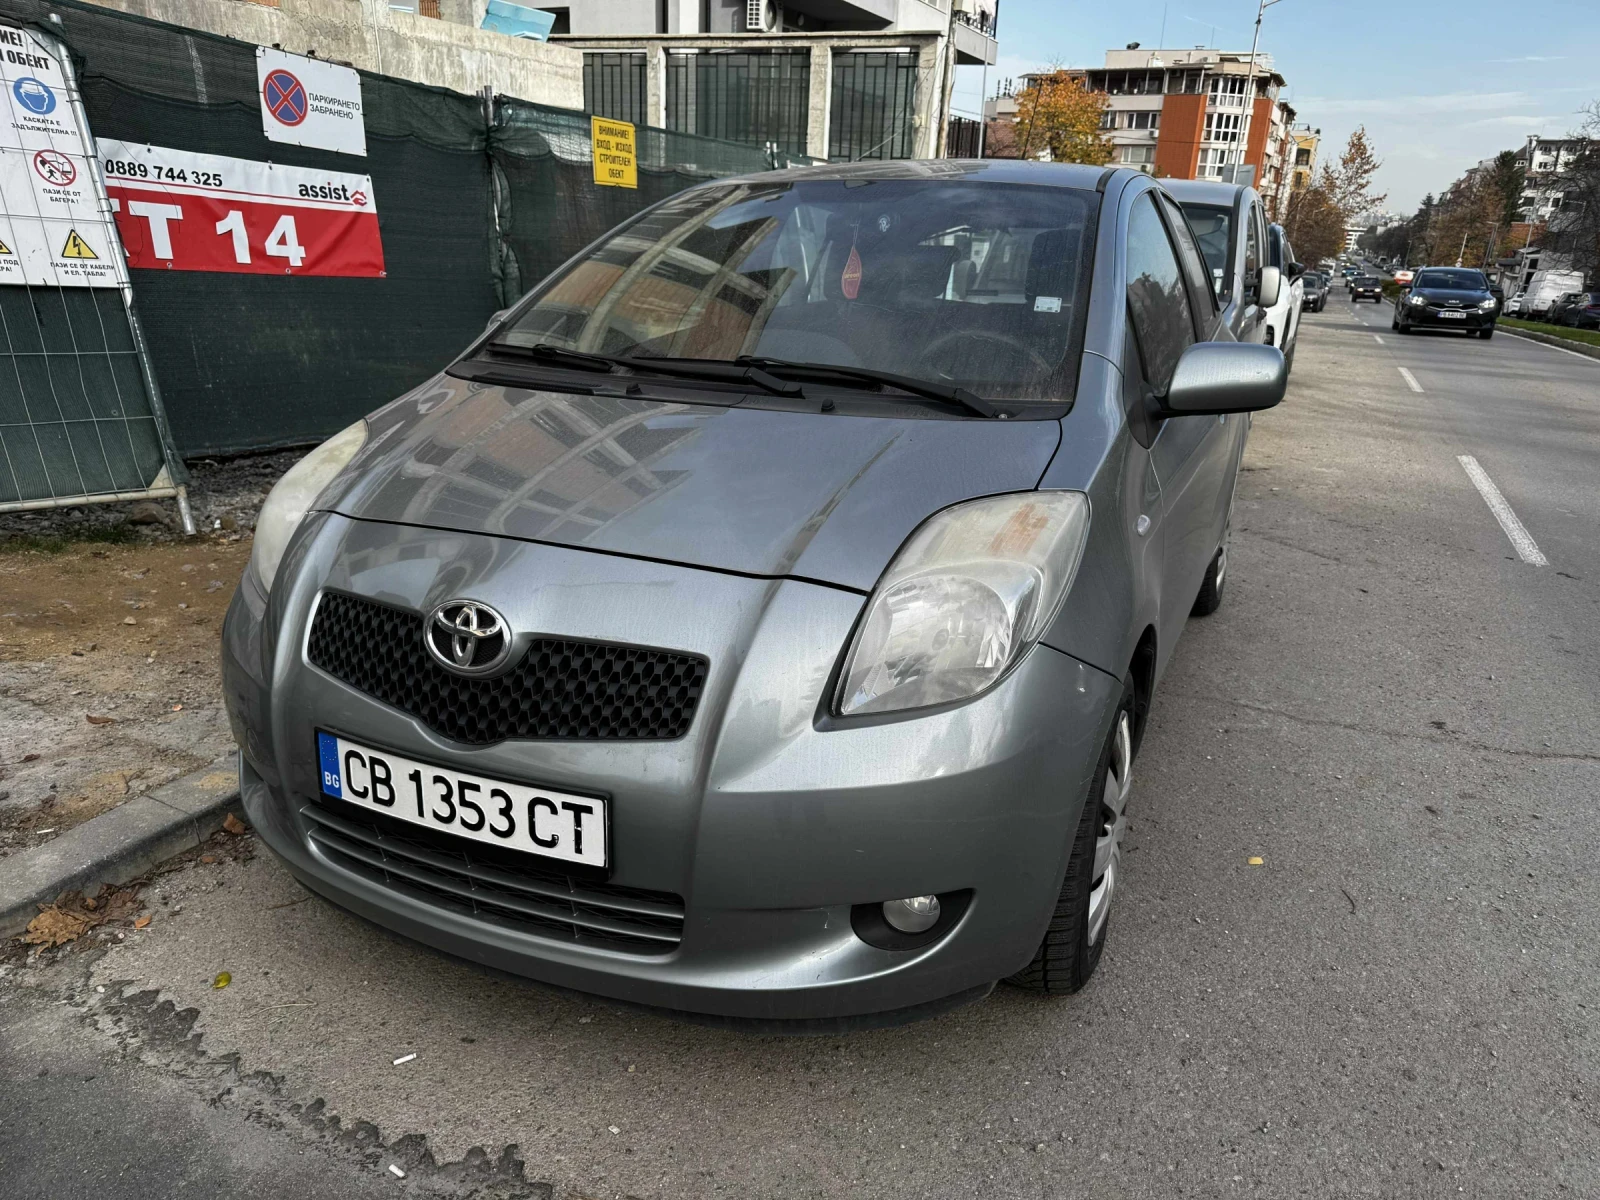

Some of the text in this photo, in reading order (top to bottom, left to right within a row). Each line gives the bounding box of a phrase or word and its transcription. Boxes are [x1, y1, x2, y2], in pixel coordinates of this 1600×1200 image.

[6, 50, 50, 70] ОБЕКТ
[309, 93, 360, 110] ПАРКИРАНЕТО
[310, 104, 354, 120] ЗАБРАНЕНО
[23, 116, 54, 125] КАСКАТА
[12, 123, 70, 136] ЗАДЪЛЖИТЕЛНА
[598, 126, 629, 140] ВНИМАНИЕ!
[596, 139, 611, 151] ВХОД
[615, 142, 632, 154] ИЗХОД
[600, 154, 631, 166] СТРОИТЕЛЕН
[106, 160, 223, 187] 0889 744 325
[608, 168, 624, 179] ОБЕКТ
[298, 182, 350, 200] assist
[216, 210, 306, 266] 14
[324, 771, 340, 788] BG
[344, 749, 594, 855] CB 1353 CT
